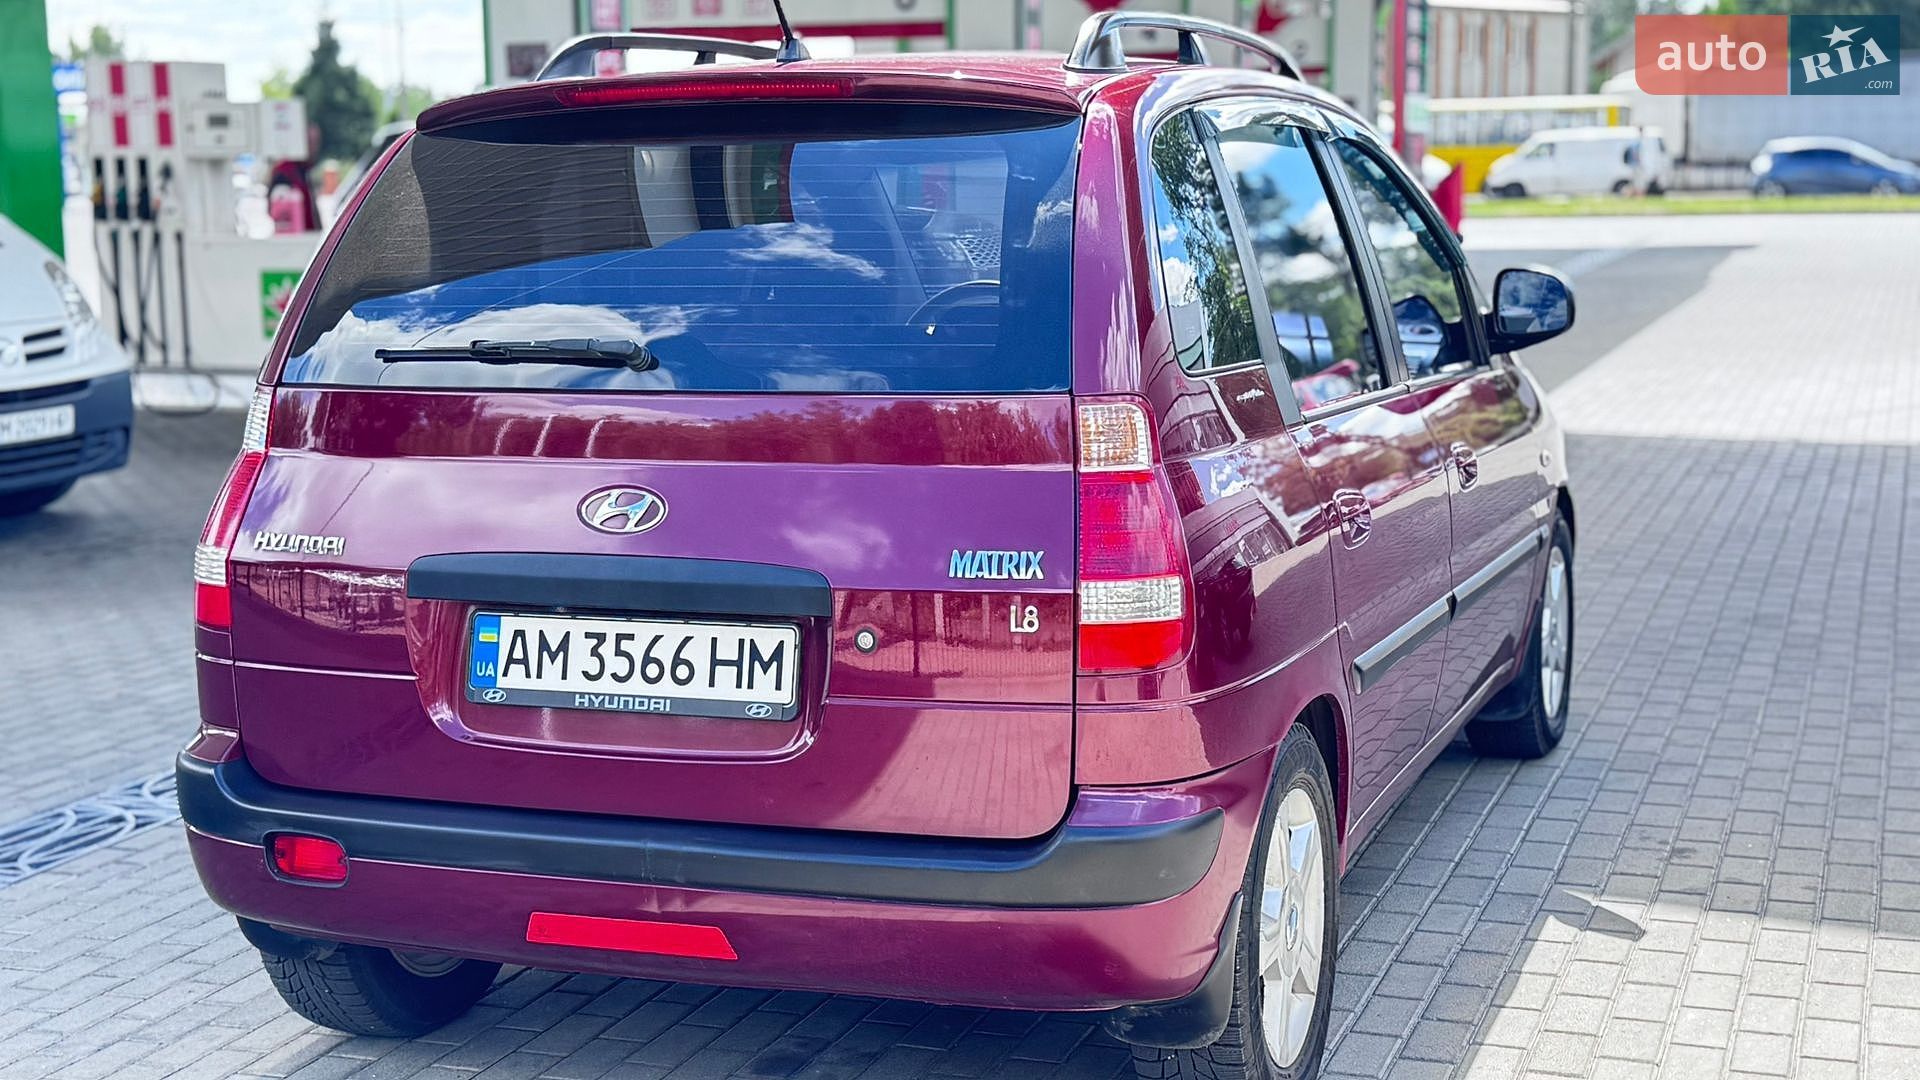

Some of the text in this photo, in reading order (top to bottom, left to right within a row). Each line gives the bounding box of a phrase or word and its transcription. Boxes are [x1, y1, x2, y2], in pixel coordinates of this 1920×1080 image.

[253, 531, 346, 556] HYUNDAI
[948, 549, 1045, 580] MATRIX
[476, 661, 495, 677] UA
[502, 629, 785, 691] AM 3566 HM
[575, 694, 671, 712] HYUNDAI
